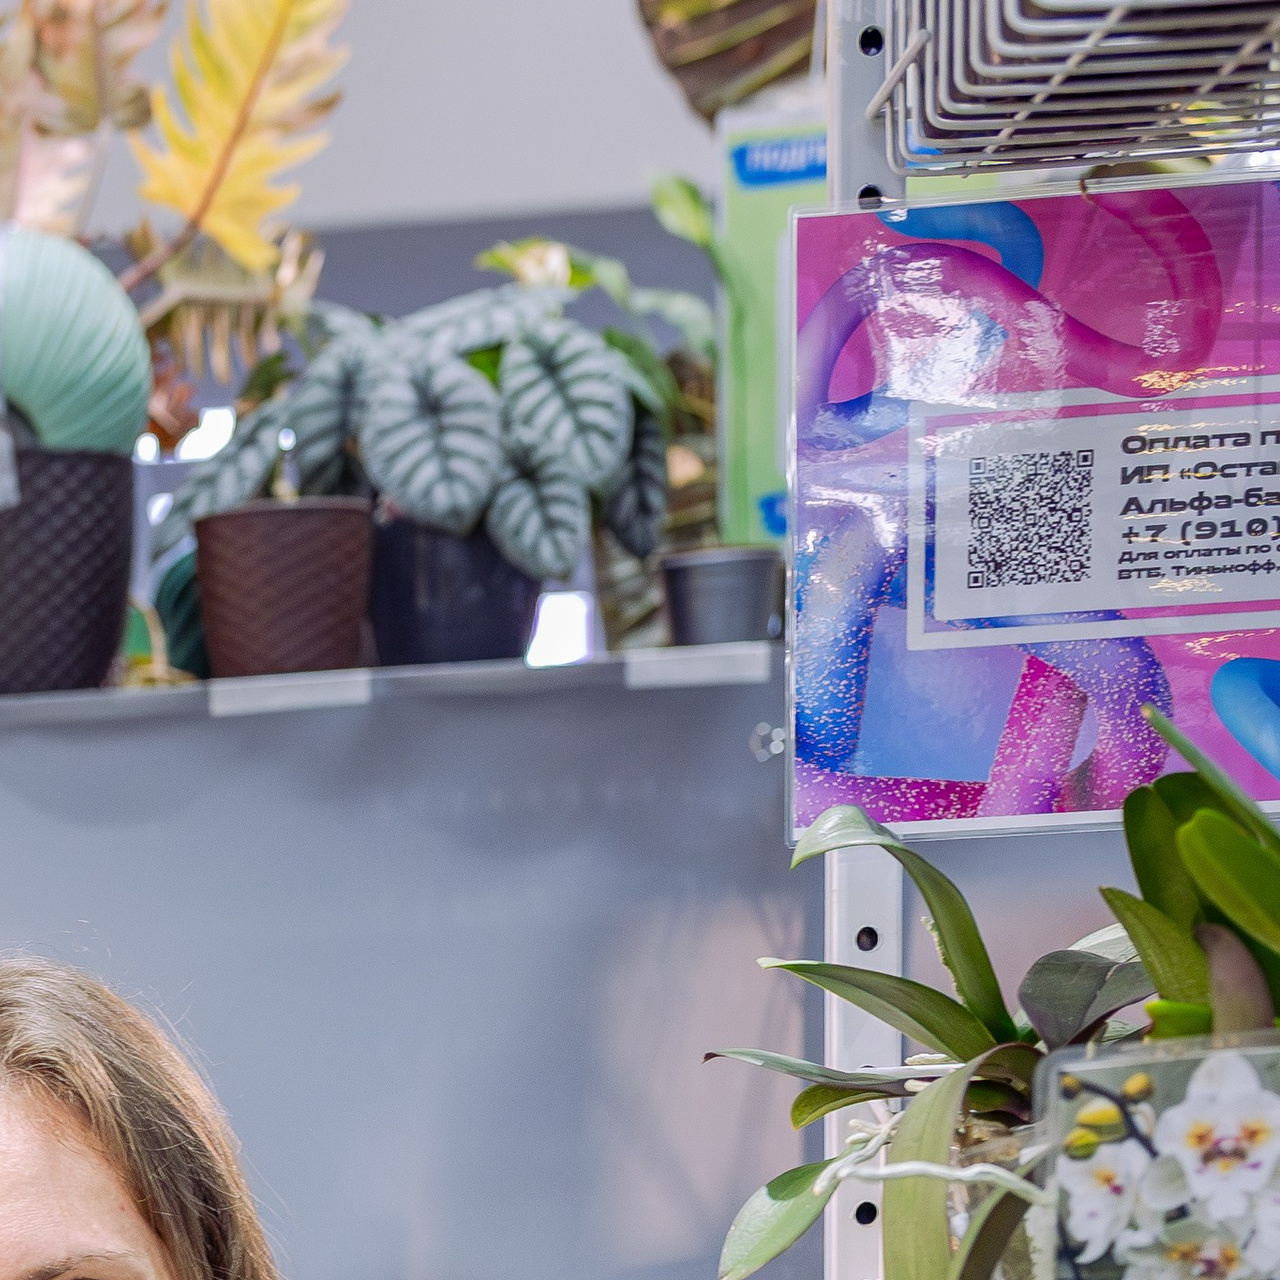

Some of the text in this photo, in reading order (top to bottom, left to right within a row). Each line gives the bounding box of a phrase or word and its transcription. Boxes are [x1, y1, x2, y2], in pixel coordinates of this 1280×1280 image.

[1122, 432, 1251, 454] Оплата
[1121, 464, 1169, 485] ИП
[1120, 487, 1280, 516] Альфа-ба
[1122, 524, 1168, 544] +7
[1118, 544, 1271, 564] Для оплаты по
[1118, 567, 1166, 580] ВТБ,
